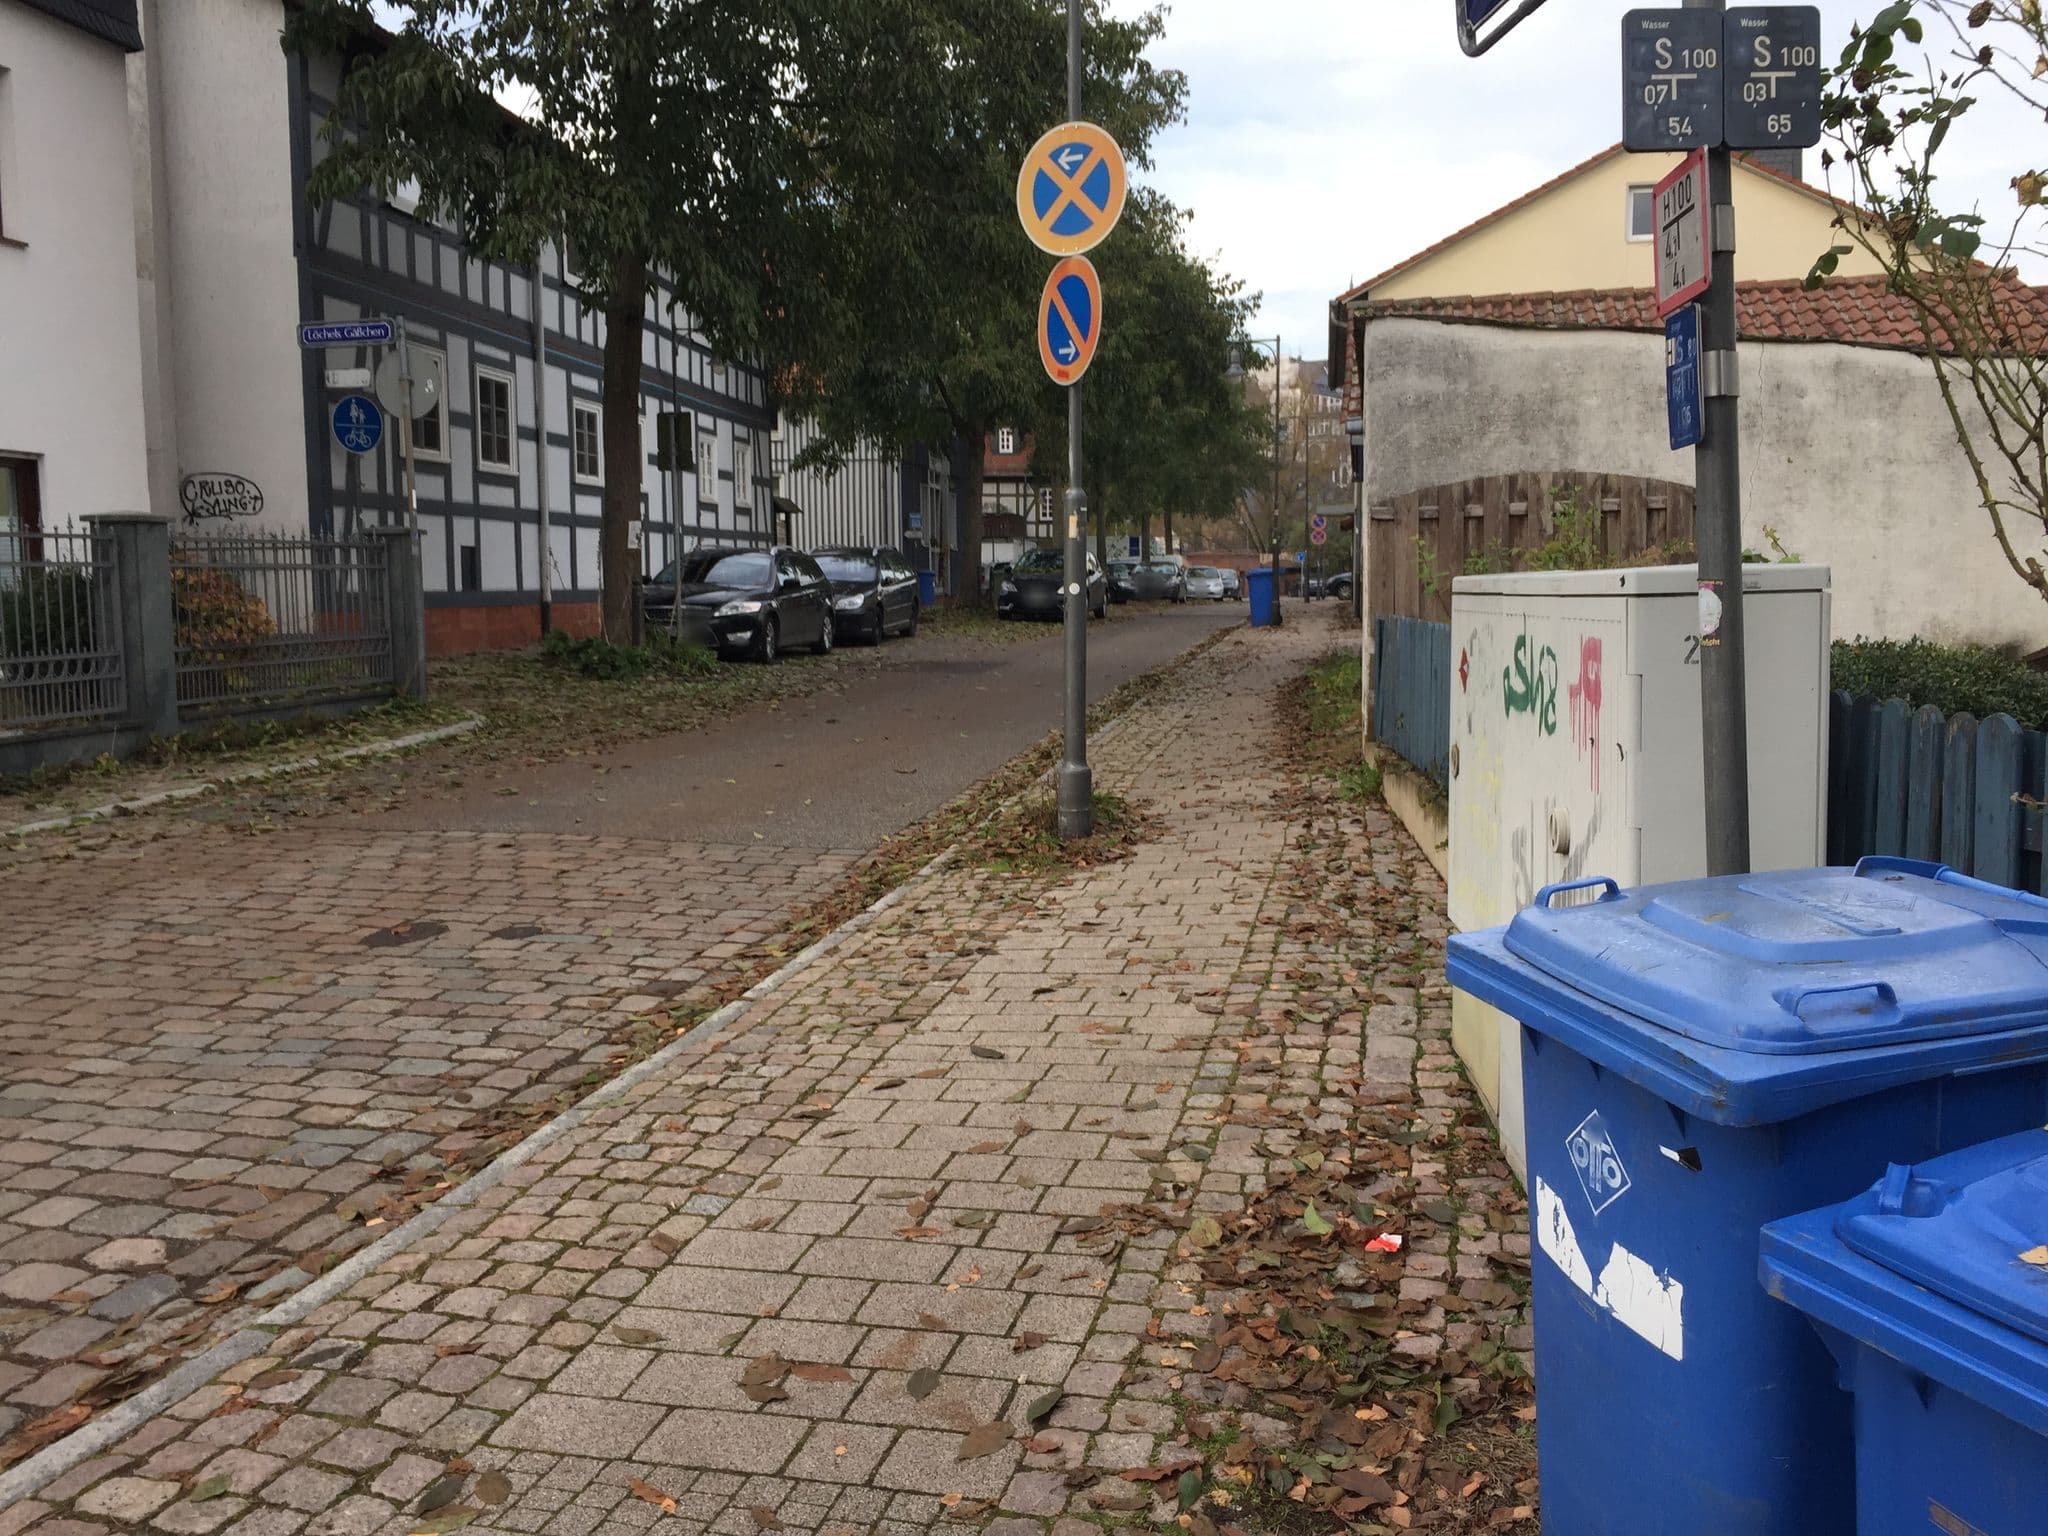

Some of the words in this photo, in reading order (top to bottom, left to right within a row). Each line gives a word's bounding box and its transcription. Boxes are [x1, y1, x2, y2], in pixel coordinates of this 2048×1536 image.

[1641, 19, 1671, 30] Wasser
[1740, 17, 1769, 28] Wasser
[1655, 37, 1673, 70] S
[1681, 48, 1718, 69] 100
[1753, 34, 1771, 68] S
[1780, 46, 1816, 67] 100
